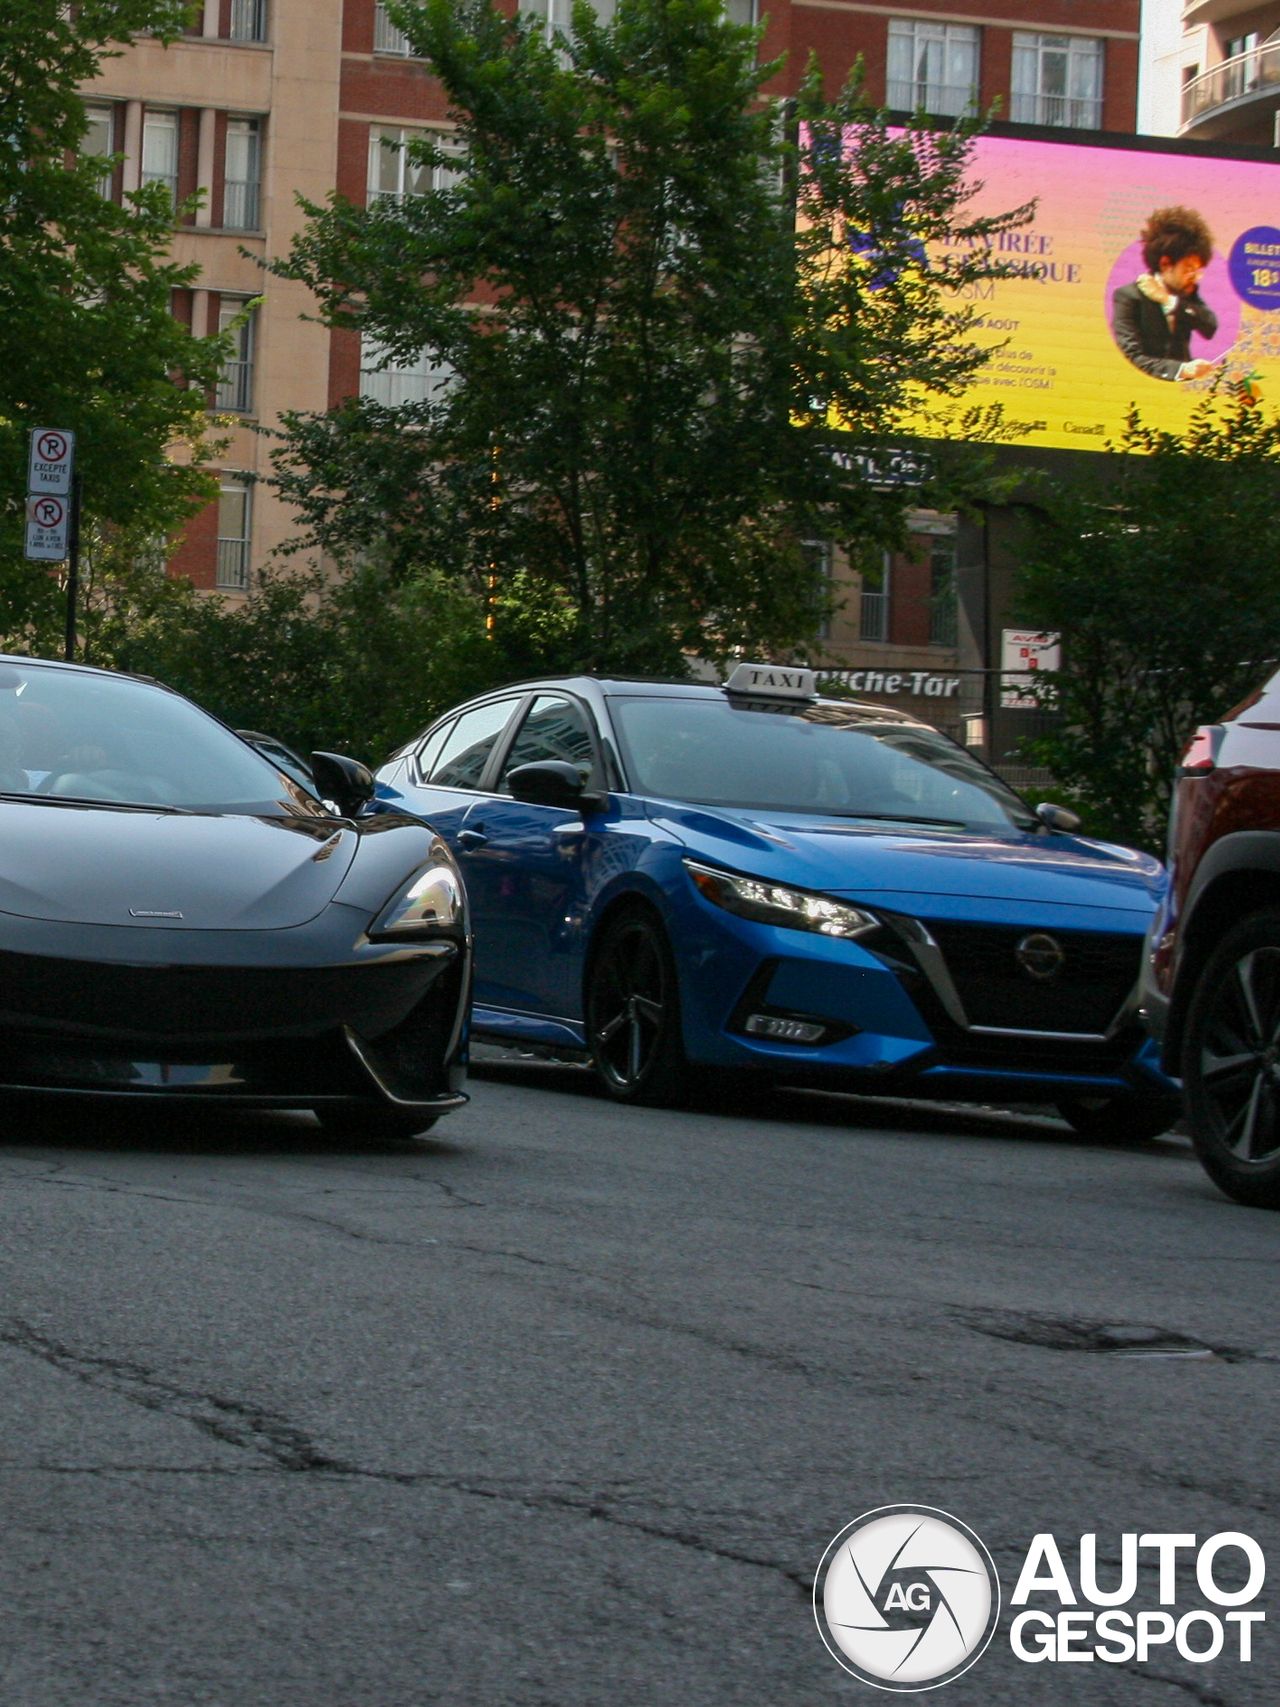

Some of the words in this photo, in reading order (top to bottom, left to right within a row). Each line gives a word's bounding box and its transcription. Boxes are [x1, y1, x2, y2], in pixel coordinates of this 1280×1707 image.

[982, 230, 1054, 256] VIRÉE
[40, 473, 61, 483] TAXIS
[749, 670, 806, 689] TAXI
